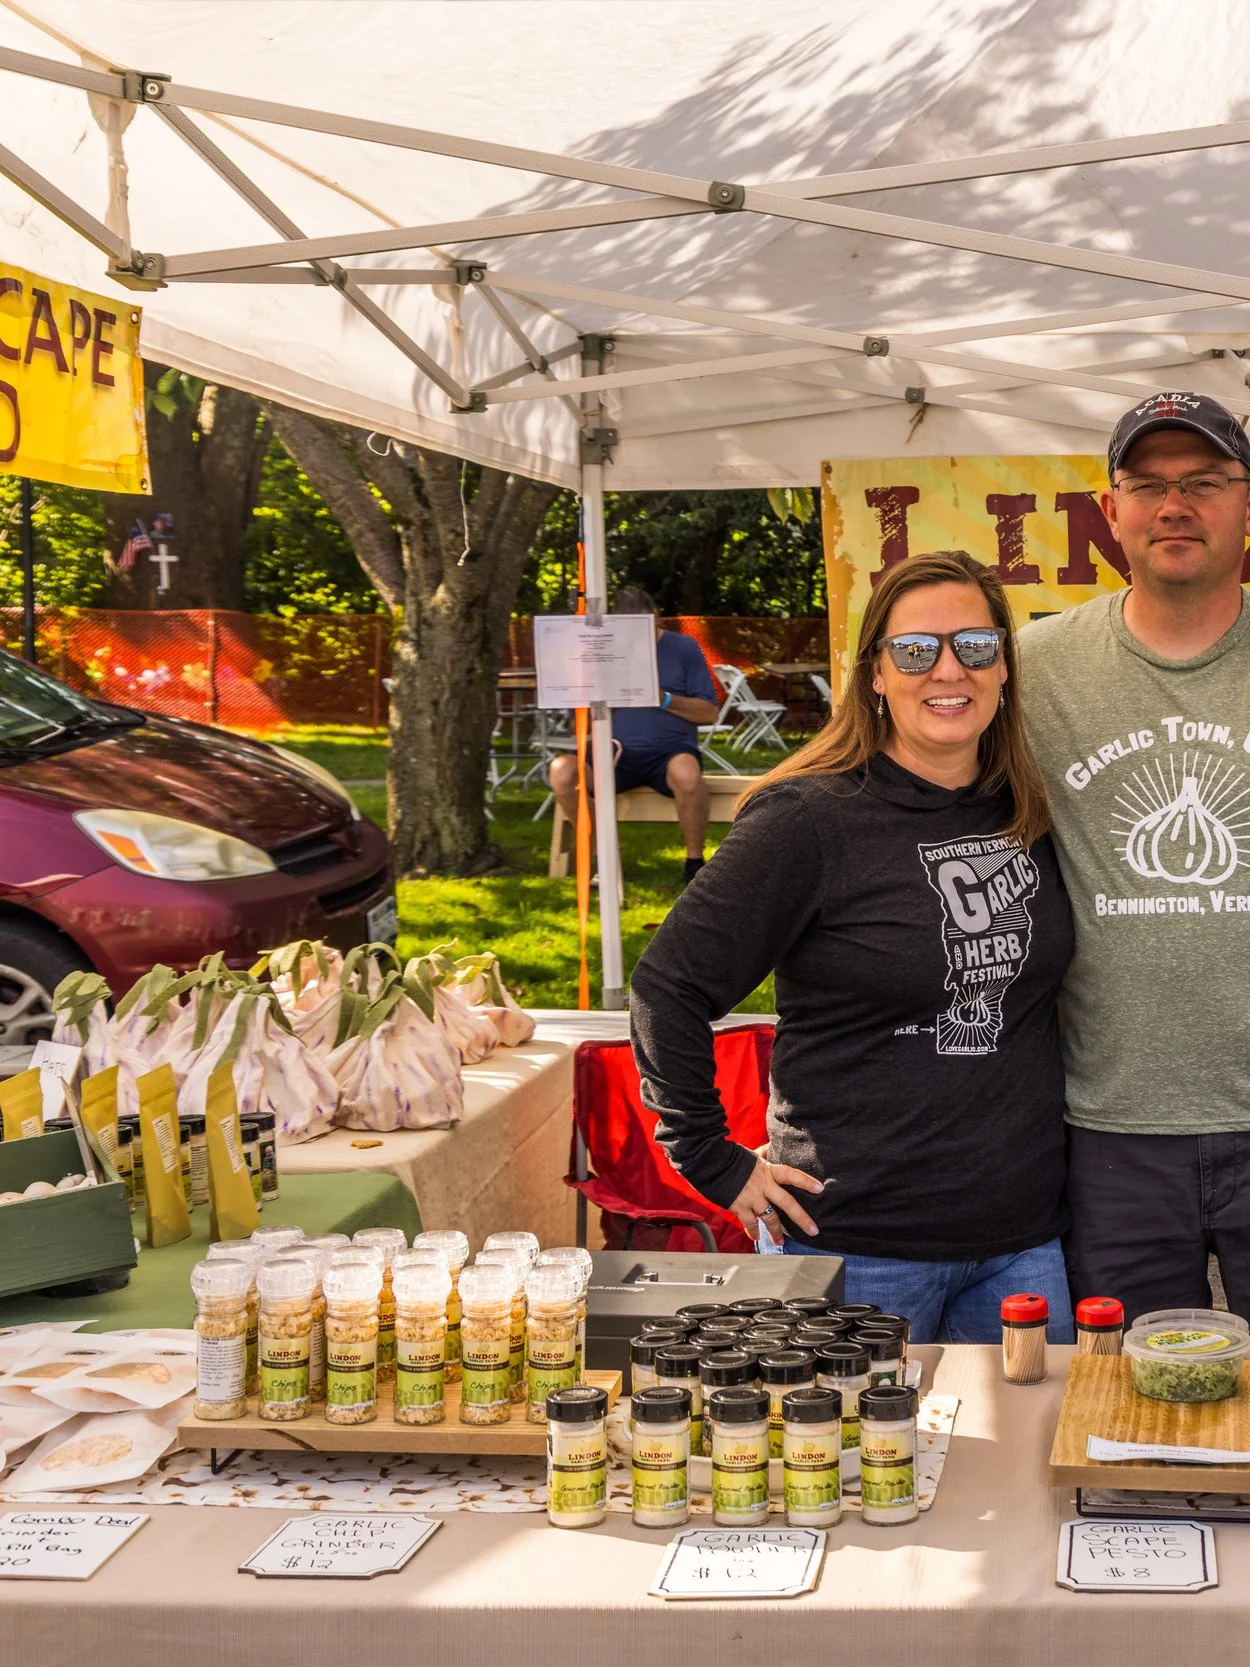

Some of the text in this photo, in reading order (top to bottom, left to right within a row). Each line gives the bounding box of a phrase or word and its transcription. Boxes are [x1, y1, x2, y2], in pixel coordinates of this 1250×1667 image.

[1135, 394, 1201, 417] ACADIA
[1065, 729, 1155, 791] GARLIC
[924, 841, 982, 861] SOUTHERN
[938, 852, 1035, 933] GARLIC
[963, 933, 1023, 968] HERB
[962, 962, 1016, 985] FESTIVAL
[268, 1350, 301, 1358] LINDON
[330, 1352, 362, 1361] LINDON
[408, 1353, 441, 1361] LINDON
[467, 1351, 499, 1360] LINDON
[533, 1350, 565, 1359] LINDON
[271, 1379, 297, 1390] Chips
[332, 1382, 358, 1394] Chips
[412, 1383, 438, 1393] Chips
[470, 1381, 496, 1392] Chips
[535, 1380, 561, 1391] Chips
[568, 1450, 602, 1461] LINDON
[639, 1450, 673, 1459] LINDON
[723, 1453, 758, 1461] LINDON
[792, 1451, 826, 1460] LINDON
[865, 1447, 897, 1456] LINDON
[312, 1518, 407, 1529] GARLIC
[1089, 1524, 1176, 1534] GARLIC
[0, 1528, 77, 1536] rinder
[315, 1528, 386, 1538] CHIP
[703, 1533, 801, 1543] GARLIC
[1081, 1533, 1183, 1547] SCAPE
[281, 1538, 396, 1550] GRINDER
[1087, 1546, 1187, 1559] PESTO
